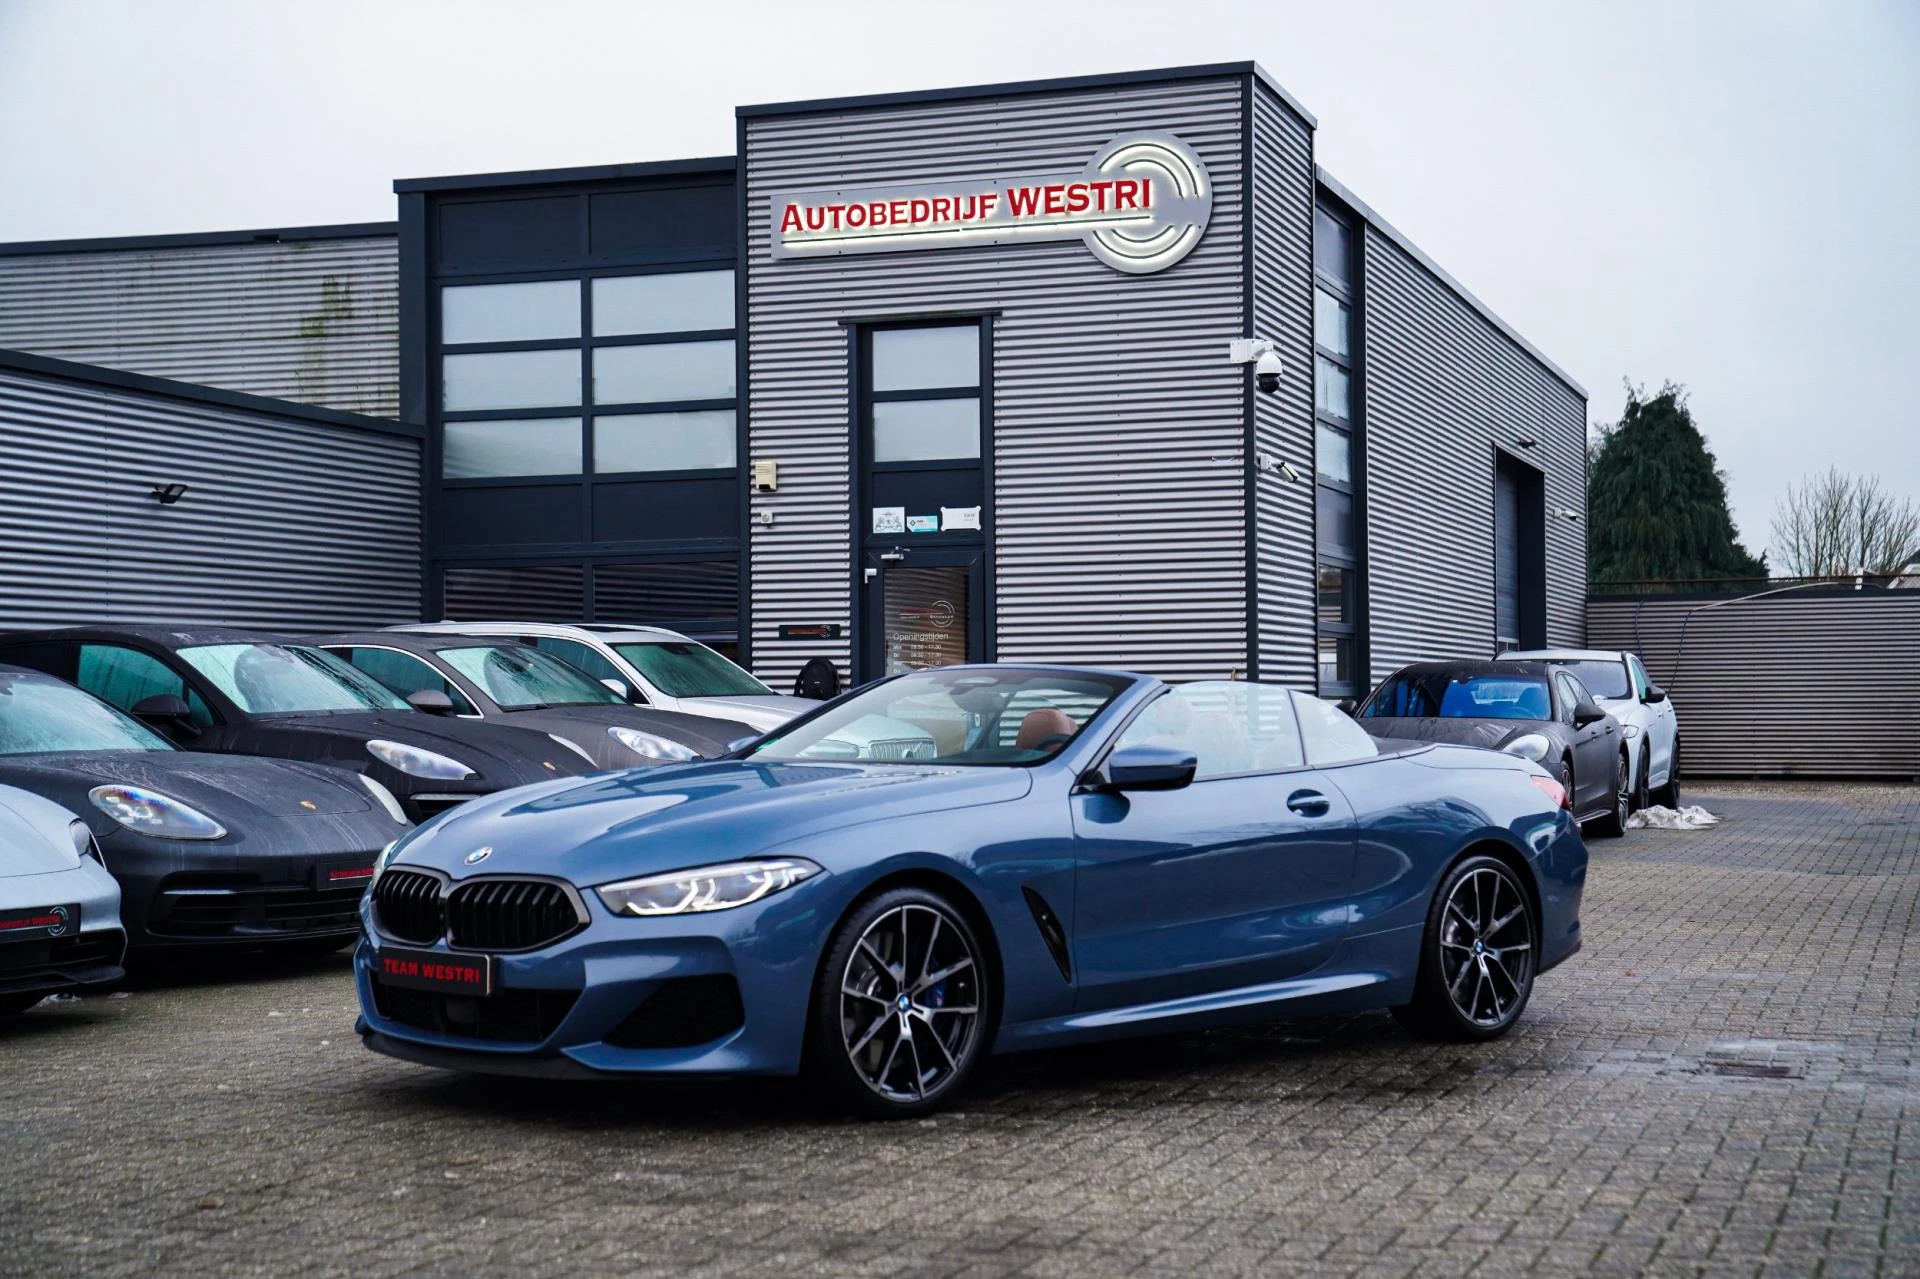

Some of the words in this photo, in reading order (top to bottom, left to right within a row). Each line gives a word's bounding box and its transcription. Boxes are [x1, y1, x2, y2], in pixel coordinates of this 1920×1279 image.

[780, 193, 998, 233] AUTOBEDRIJF
[1007, 179, 1151, 217] WESTRI
[893, 632, 949, 641] Openingstijden
[383, 958, 418, 976] TEAM
[422, 963, 480, 984] WESTRI
